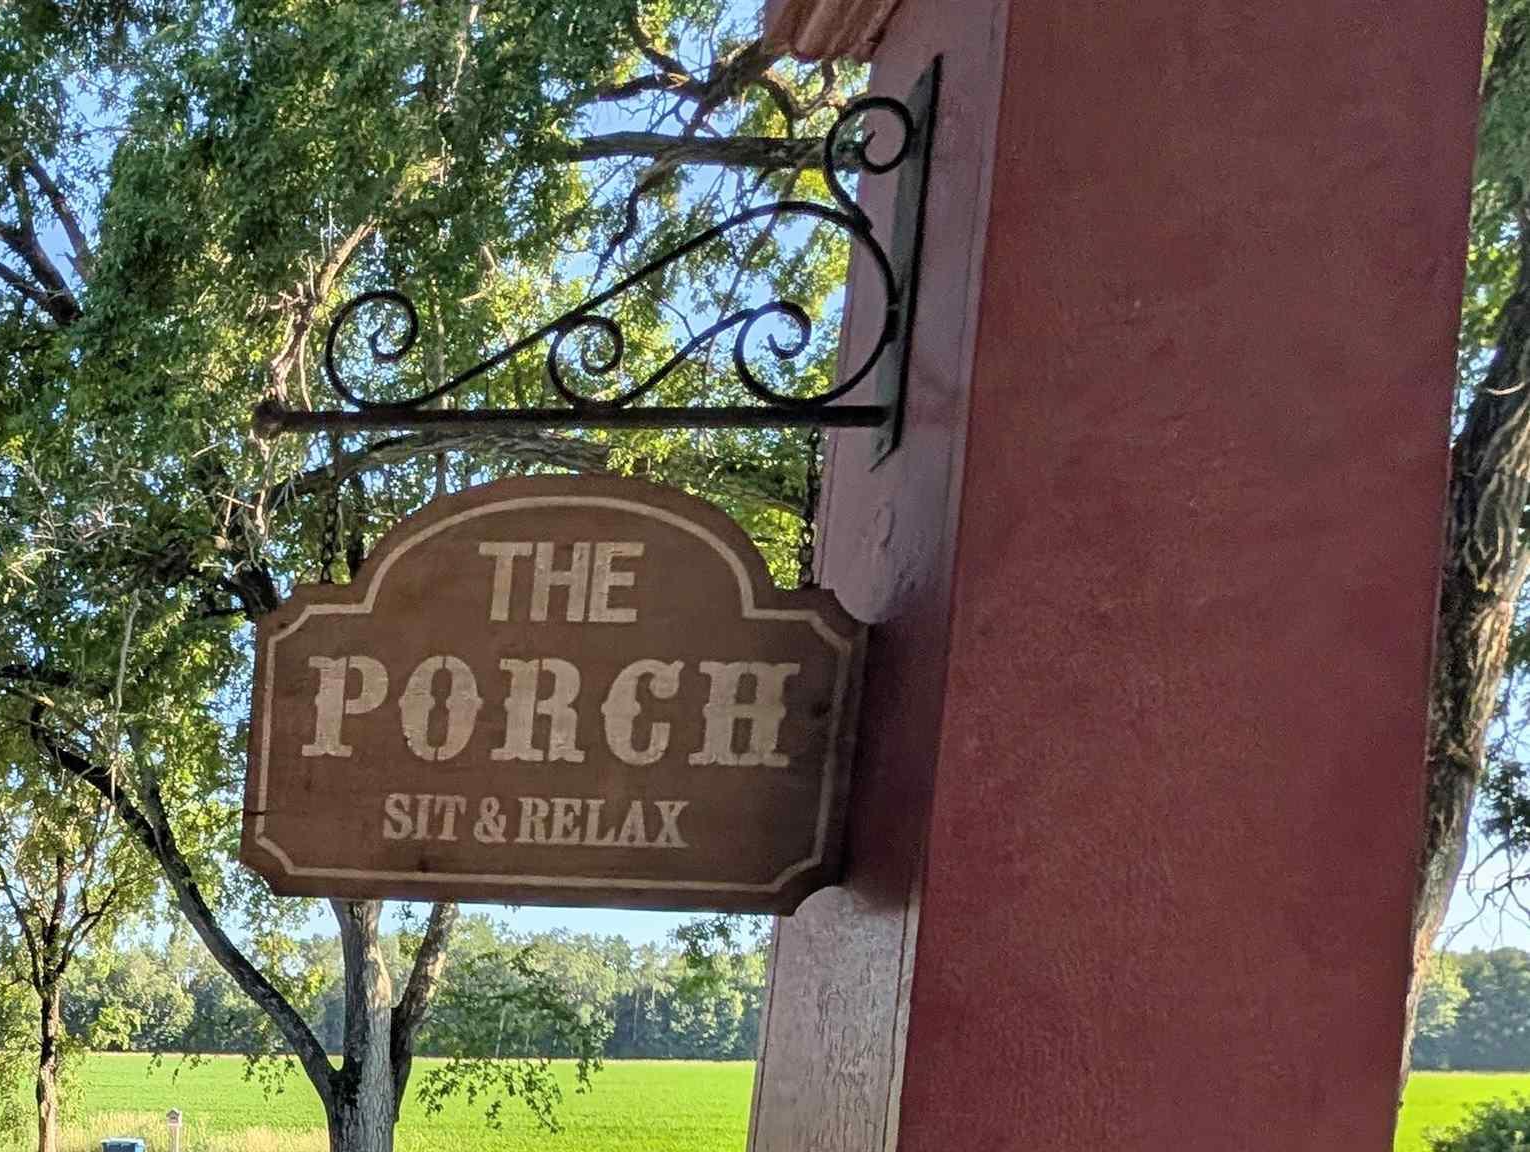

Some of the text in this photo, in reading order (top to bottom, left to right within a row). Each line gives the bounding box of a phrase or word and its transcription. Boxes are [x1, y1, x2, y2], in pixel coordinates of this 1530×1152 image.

[479, 541, 645, 623] THE
[301, 655, 801, 766] PORCH
[383, 793, 691, 849] SIT & RELAX
